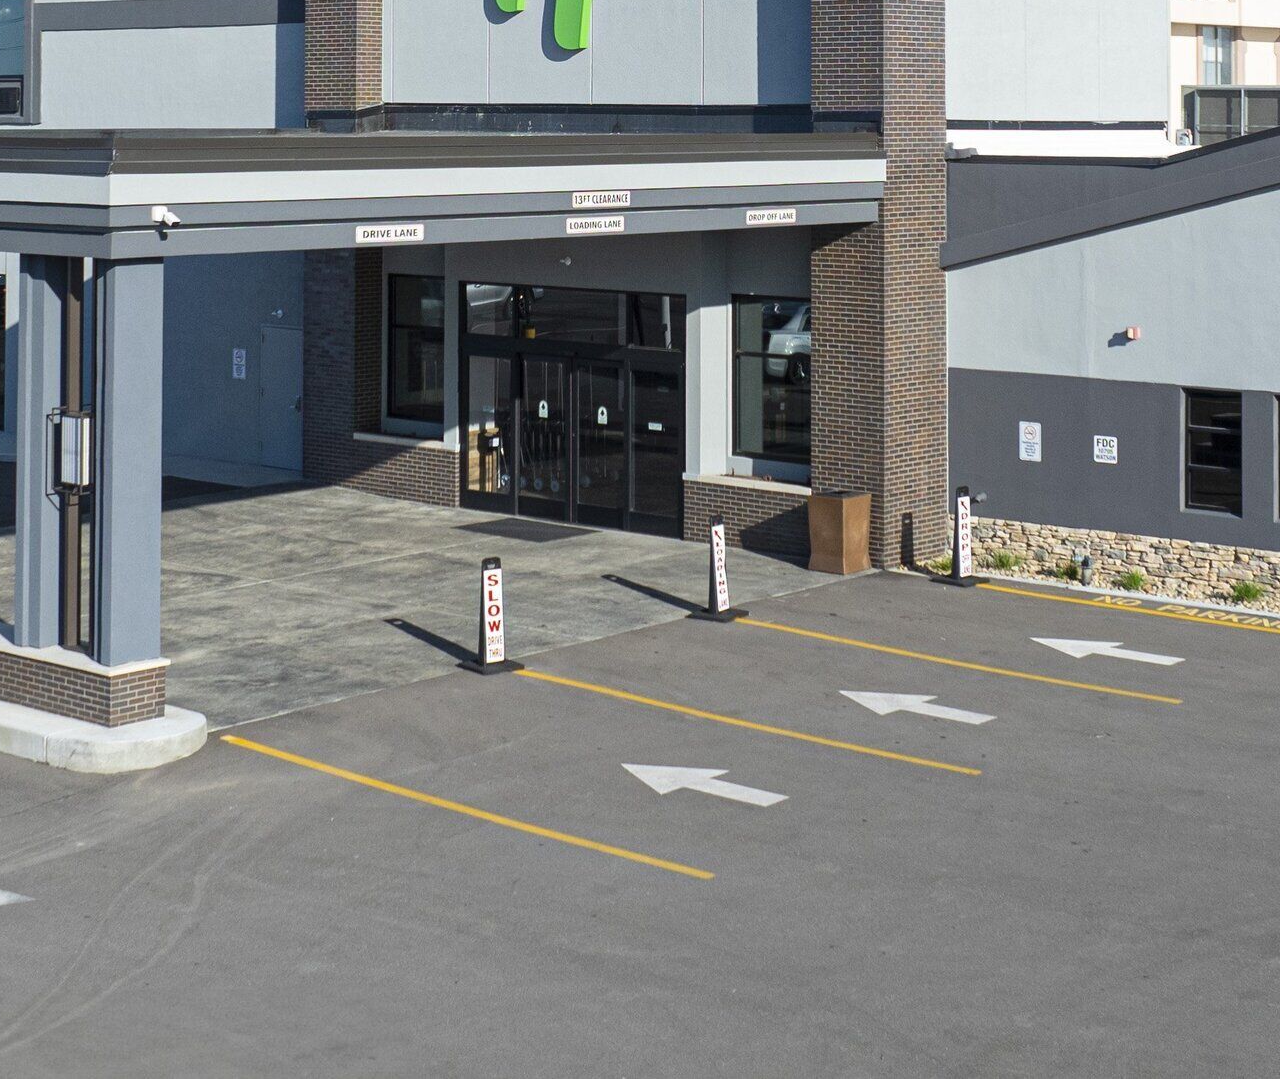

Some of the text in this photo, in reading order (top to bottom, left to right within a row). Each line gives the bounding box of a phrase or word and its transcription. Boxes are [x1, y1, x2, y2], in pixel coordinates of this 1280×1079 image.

[574, 193, 628, 204] 13FT CLEARANCE
[748, 212, 794, 221] DROP OFF LANE
[569, 220, 621, 230] LOADING LANE
[362, 228, 418, 239] DRIVE LANE
[1096, 437, 1115, 448] FDC
[1095, 454, 1117, 462] WATSON
[961, 512, 969, 552] DROP
[716, 542, 726, 595] LOADING
[487, 573, 502, 633] SLOW
[1093, 595, 1143, 607] NO
